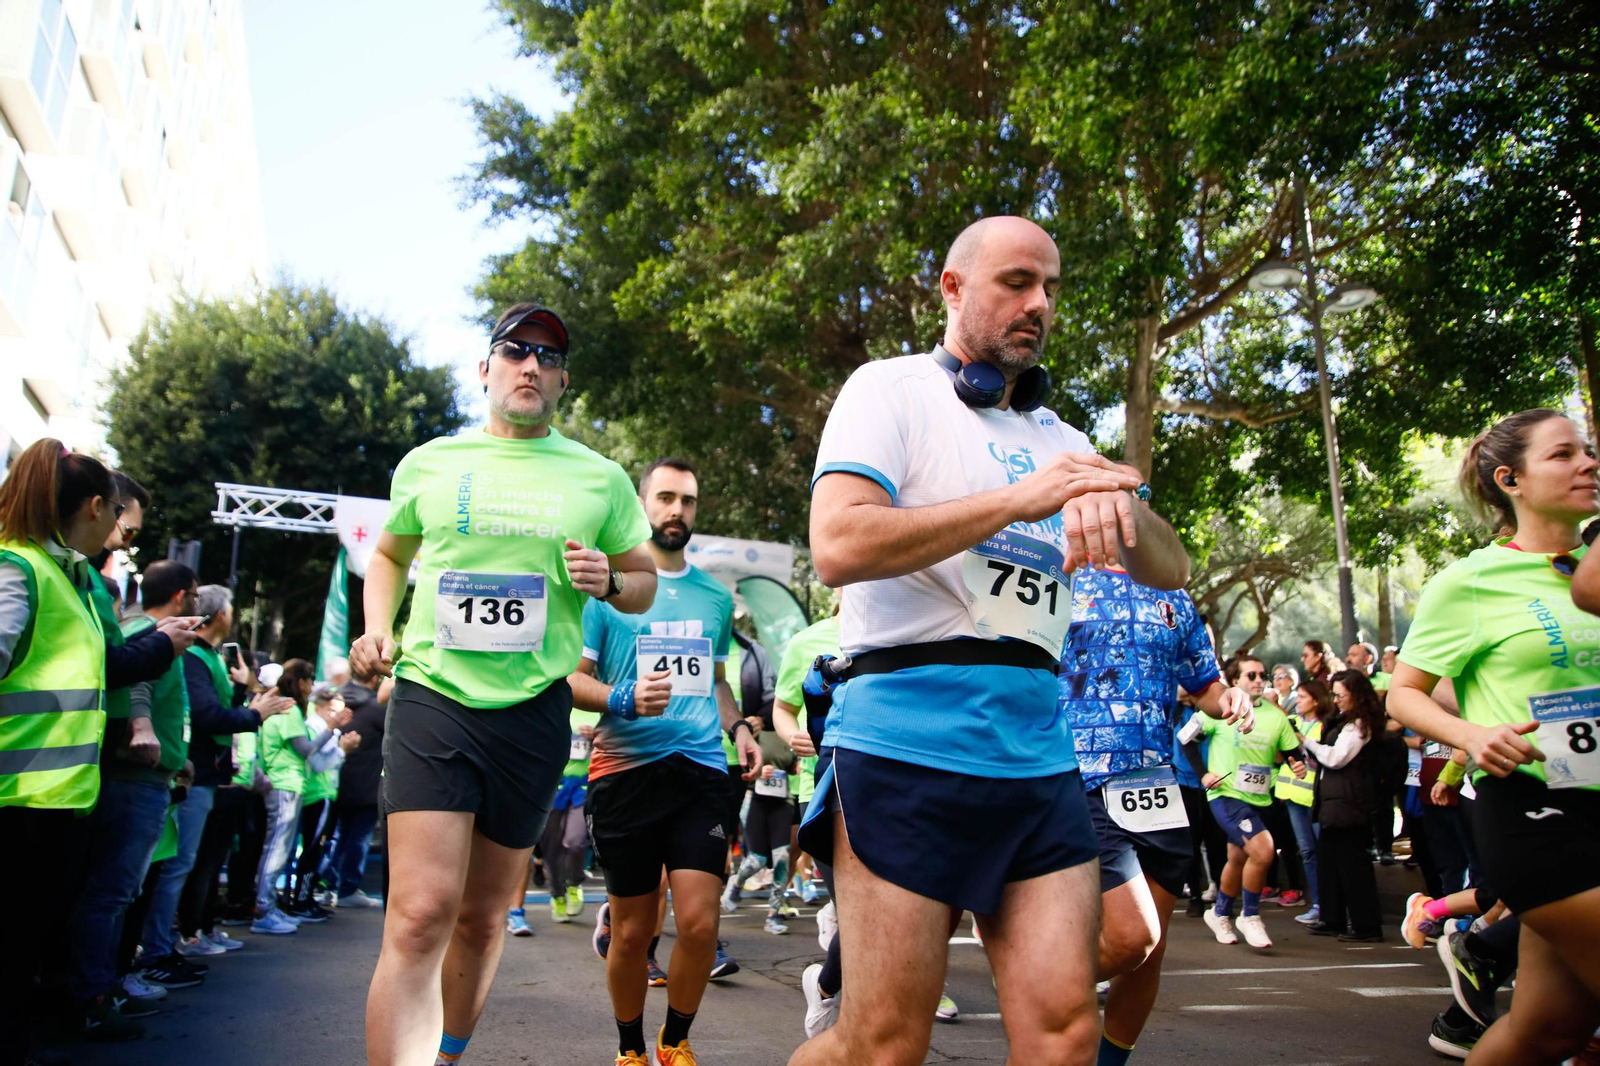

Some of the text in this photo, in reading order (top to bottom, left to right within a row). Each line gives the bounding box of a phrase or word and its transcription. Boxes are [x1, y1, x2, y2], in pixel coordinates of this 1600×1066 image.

[475, 486, 565, 503] En marcha
[457, 472, 473, 536] ALMERÍA
[475, 501, 562, 518] contra el
[474, 517, 562, 539] cáncer
[1001, 543, 1011, 552] el
[1012, 546, 1043, 561] cáncer
[442, 582, 465, 590] contra
[474, 583, 500, 591] cáncer
[986, 559, 1059, 616] 751
[458, 597, 525, 626] 136
[1527, 598, 1569, 669] ALMERÍA
[1570, 629, 1600, 643] co
[653, 655, 700, 676] 416
[1534, 695, 1573, 706] Almería
[1537, 705, 1569, 715] contra
[1570, 702, 1581, 711] el
[1244, 772, 1266, 785] 258
[1121, 787, 1169, 812] 655
